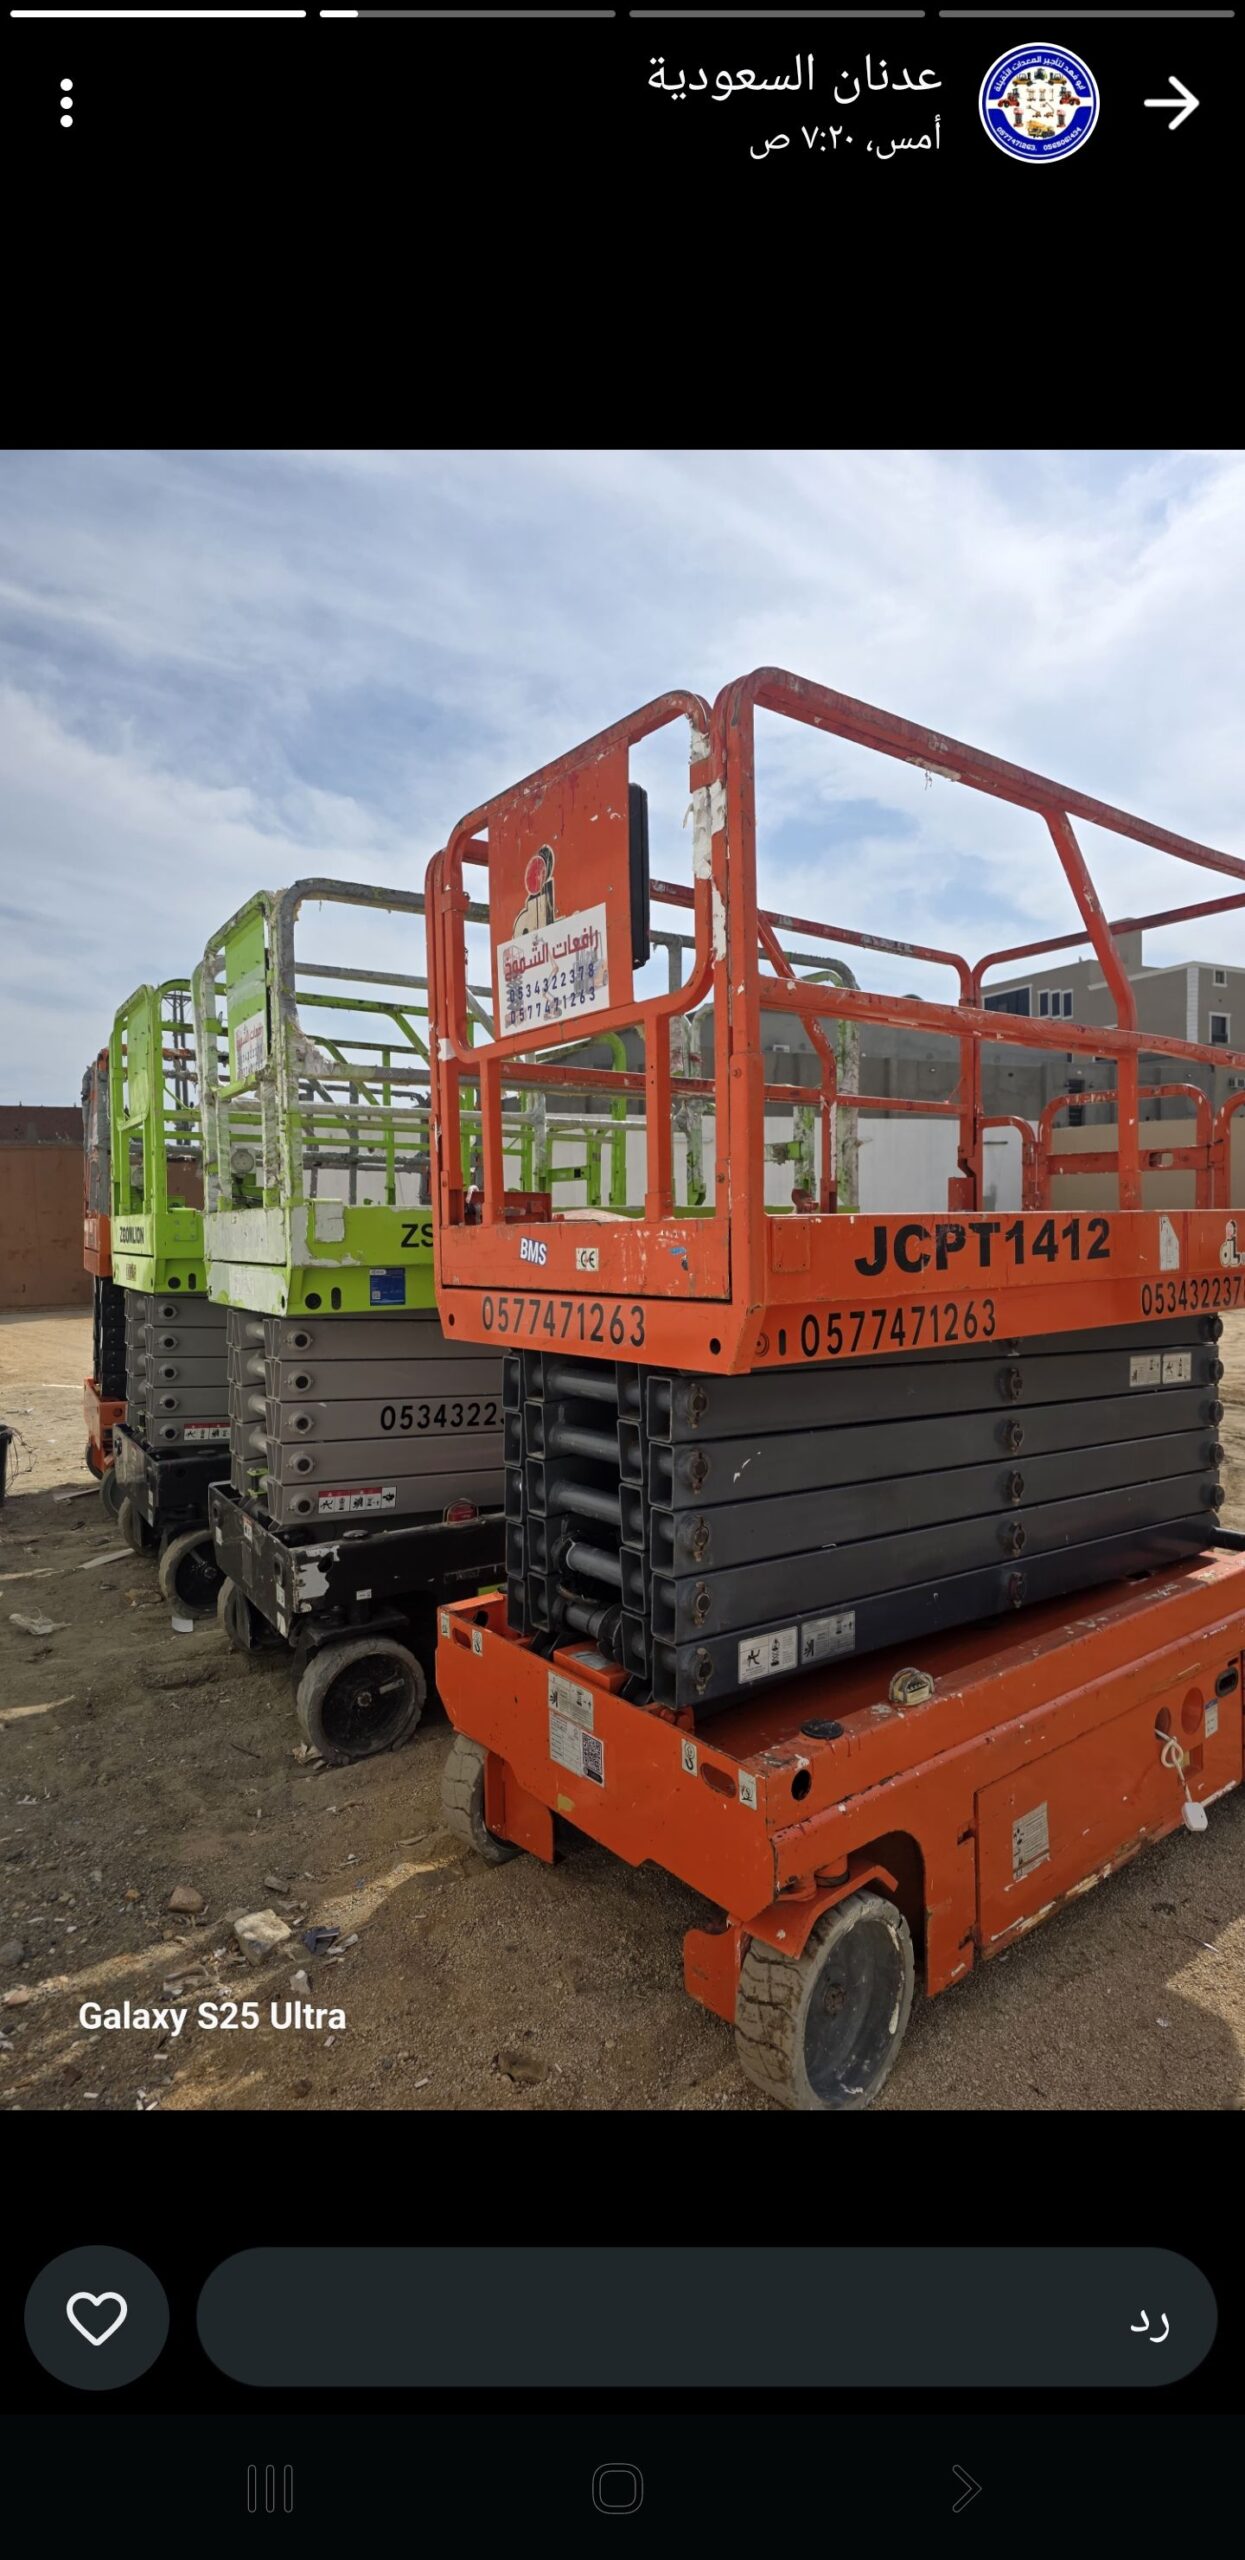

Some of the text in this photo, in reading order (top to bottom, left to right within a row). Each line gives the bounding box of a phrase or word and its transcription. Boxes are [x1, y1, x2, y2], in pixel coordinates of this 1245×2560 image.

[504, 925, 599, 982] رافعات الشموخ
[508, 963, 595, 1003] 0534322378
[510, 986, 596, 1025] 0577471263
[520, 1238, 547, 1266] BMS
[854, 1217, 1111, 1277] JCPT1412
[1141, 1276, 1245, 1316] 053432237
[482, 1295, 645, 1347] 0577471263
[800, 1298, 997, 1358] 0577471263
[380, 1402, 504, 1431] 0534322
